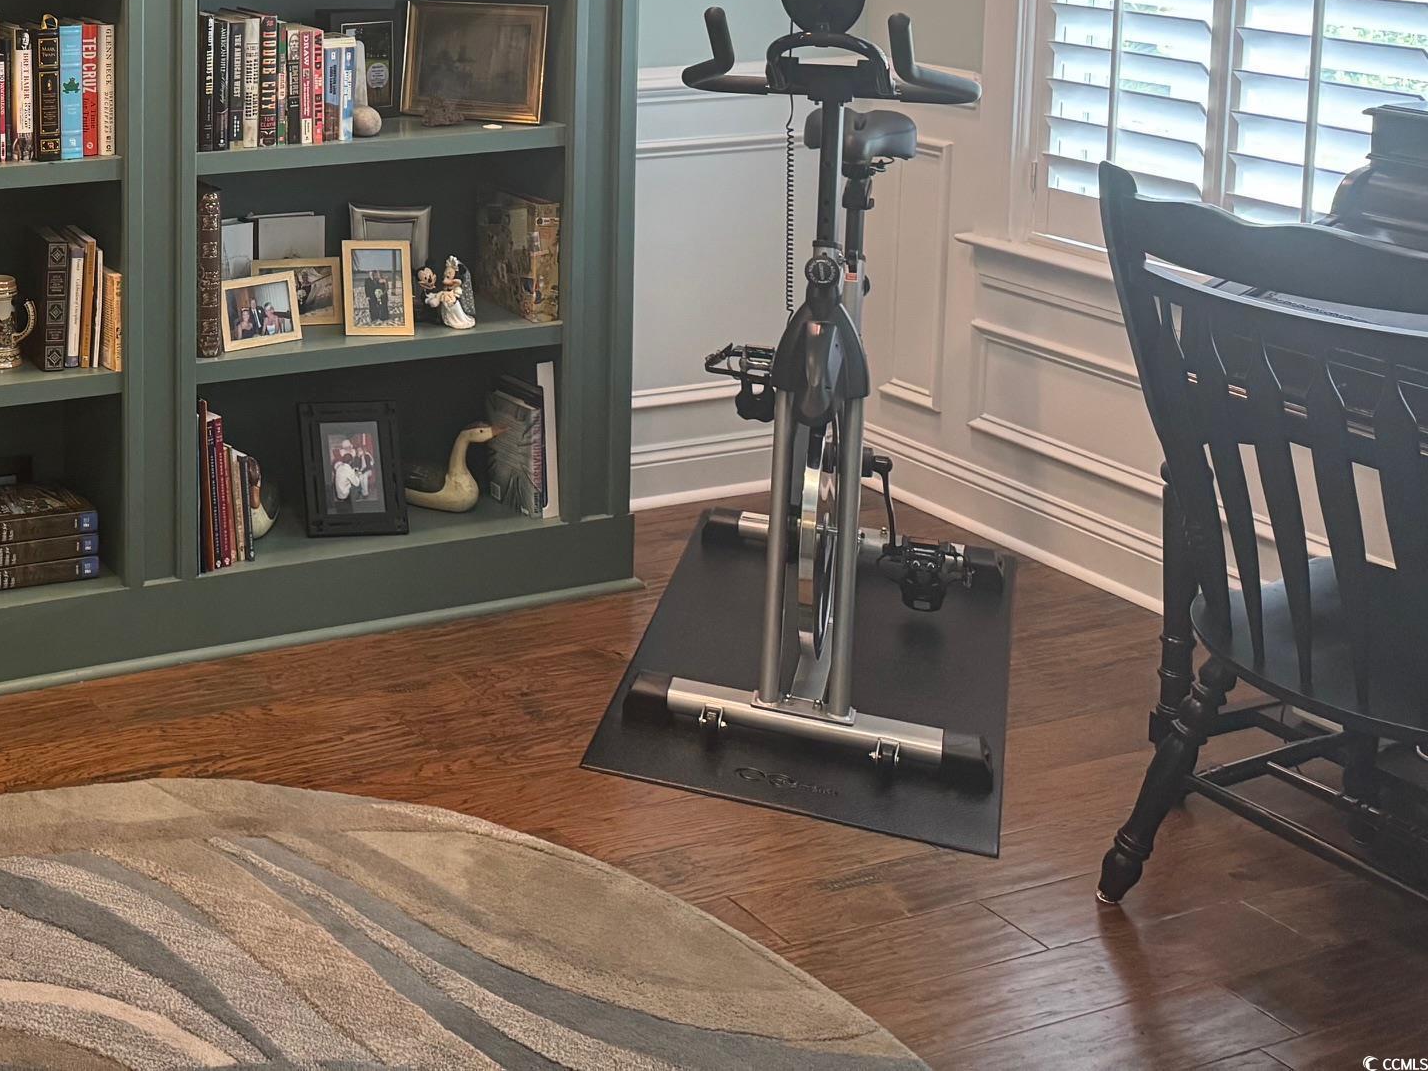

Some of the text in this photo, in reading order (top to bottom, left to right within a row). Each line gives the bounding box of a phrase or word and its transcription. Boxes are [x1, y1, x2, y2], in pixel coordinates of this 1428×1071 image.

[82, 37, 97, 94] TED CRUZ
[262, 31, 277, 109] DODGE CITY
